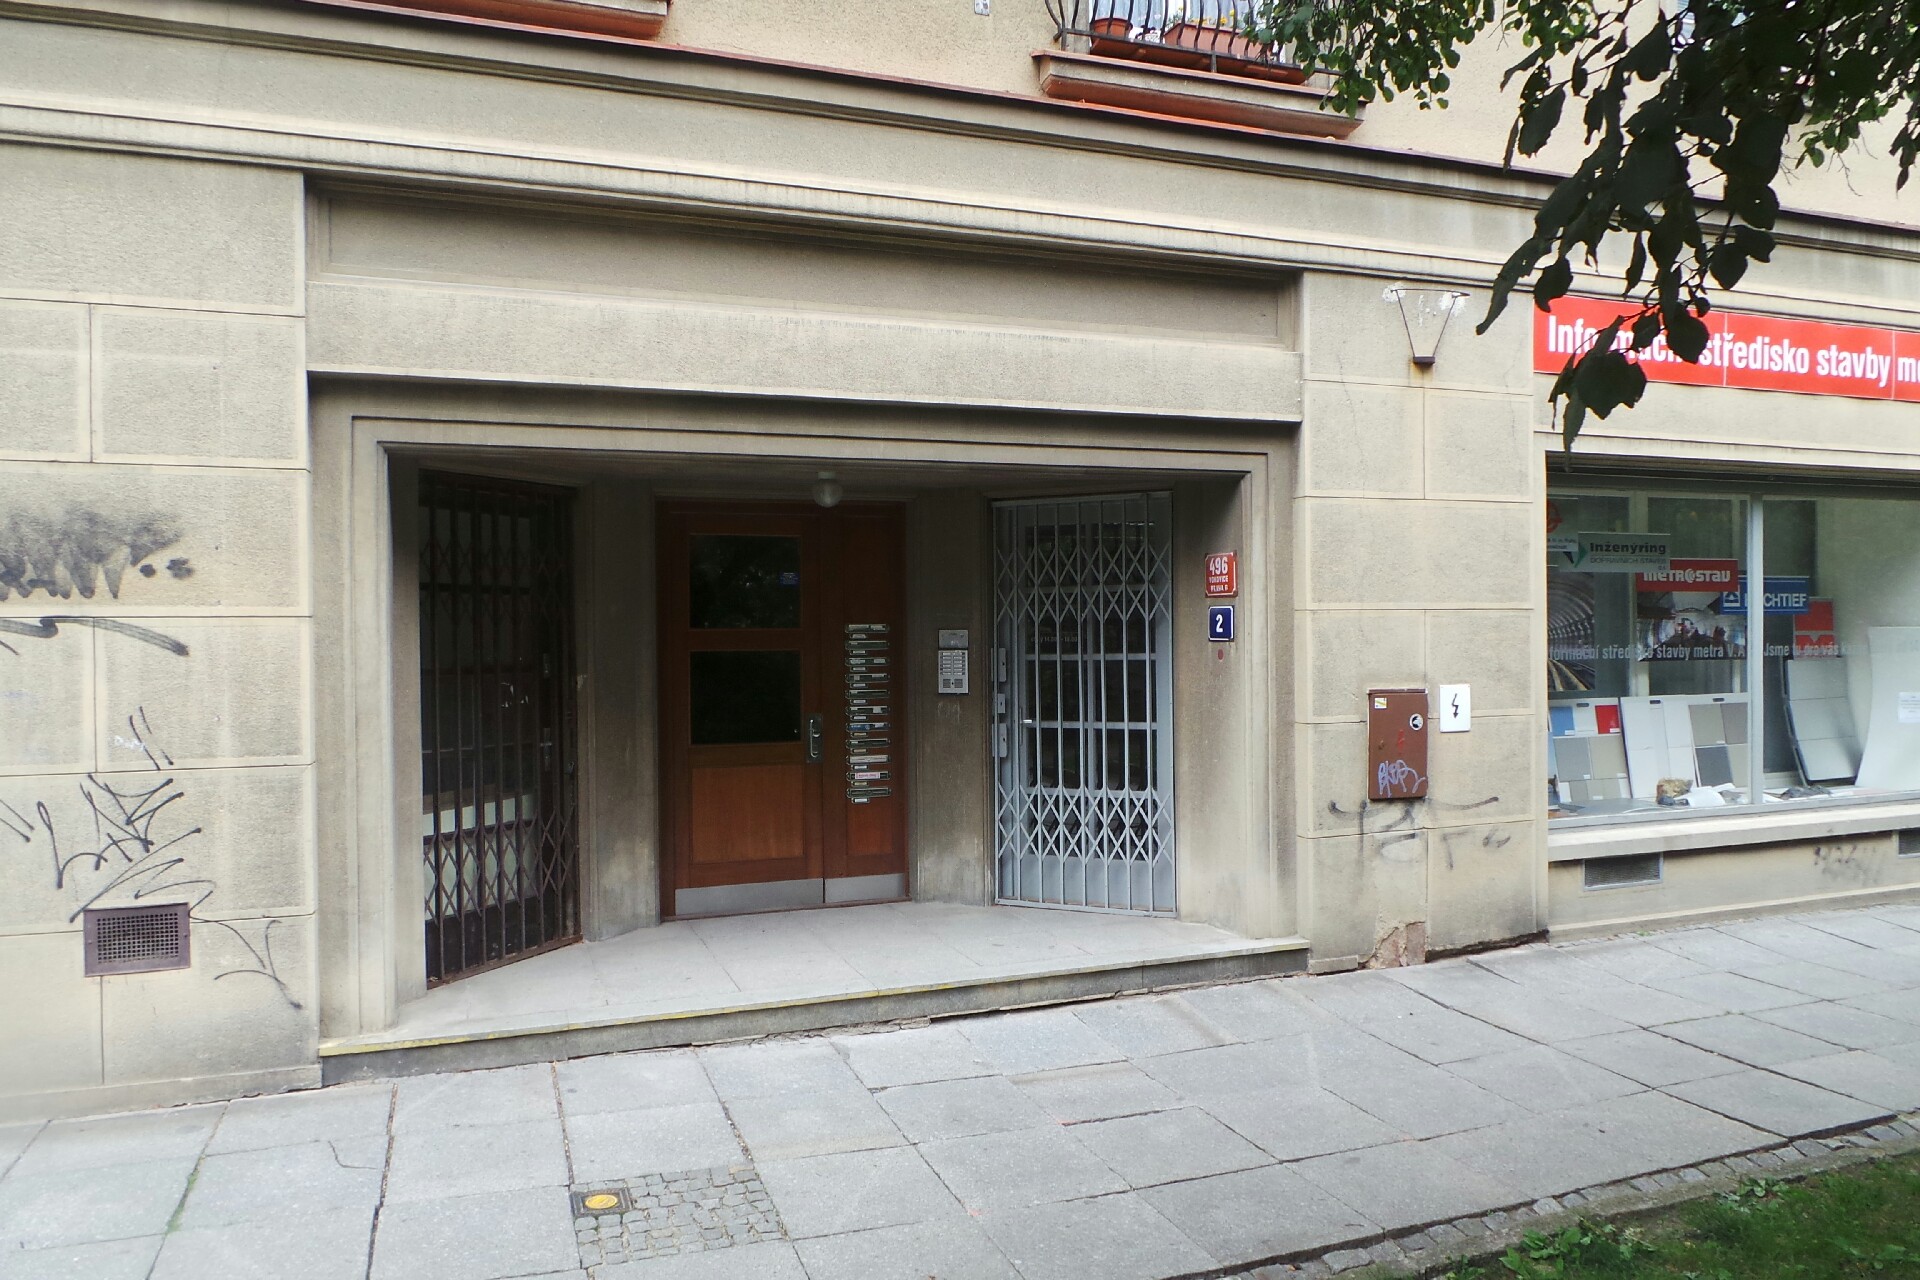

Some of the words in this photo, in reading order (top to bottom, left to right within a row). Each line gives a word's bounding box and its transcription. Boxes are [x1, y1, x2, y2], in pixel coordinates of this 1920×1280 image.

[1700, 331, 1810, 375] středisko
[1816, 344, 1891, 388] stavby
[1898, 356, 1920, 384] m
[1209, 557, 1228, 575] 496
[1215, 614, 1223, 633] 2
[1656, 644, 1691, 660] stavby
[1693, 644, 1724, 658] metra
[1763, 643, 1790, 657] Jsme
